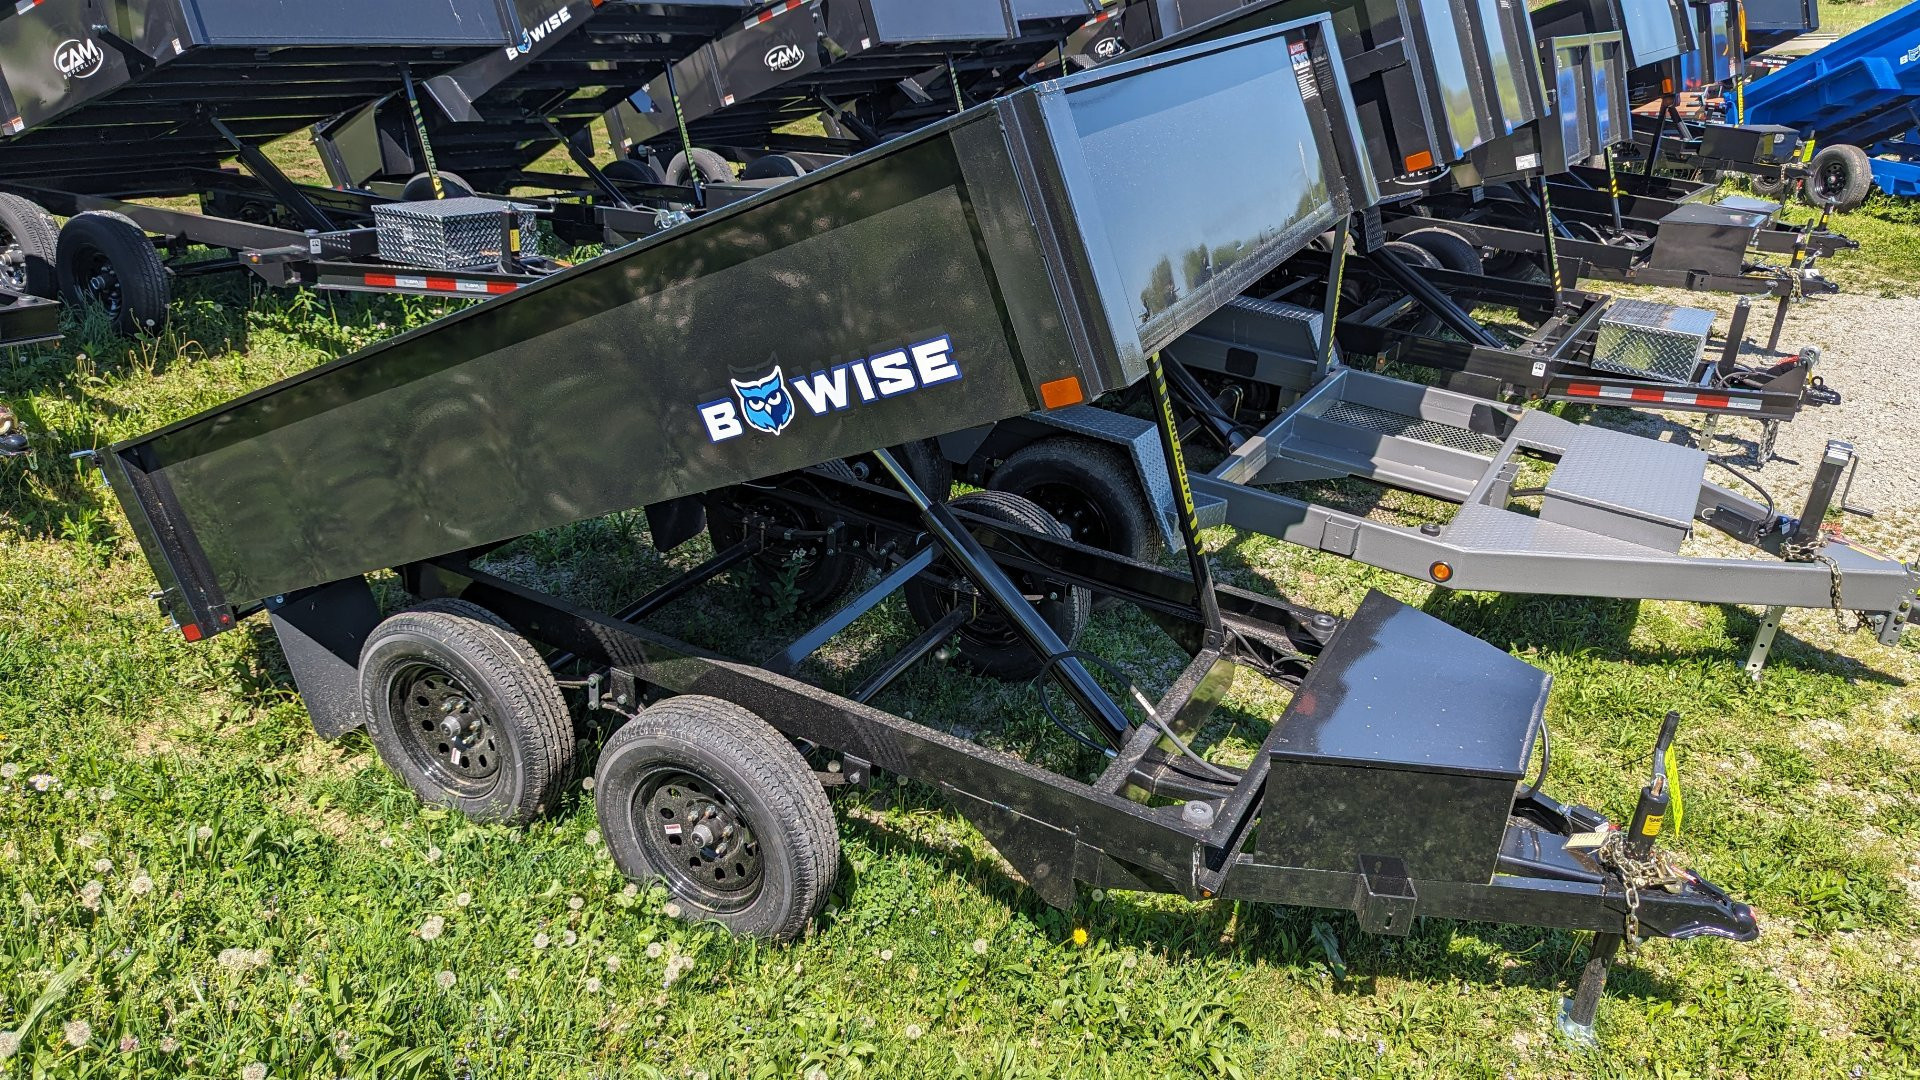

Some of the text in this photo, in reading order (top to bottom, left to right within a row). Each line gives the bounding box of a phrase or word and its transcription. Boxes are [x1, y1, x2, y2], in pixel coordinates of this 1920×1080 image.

[58, 38, 99, 73] CAM
[768, 44, 802, 67] CAM
[420, 128, 441, 186] SAFETY PROP
[1165, 401, 1193, 505] SAFETY PROP
